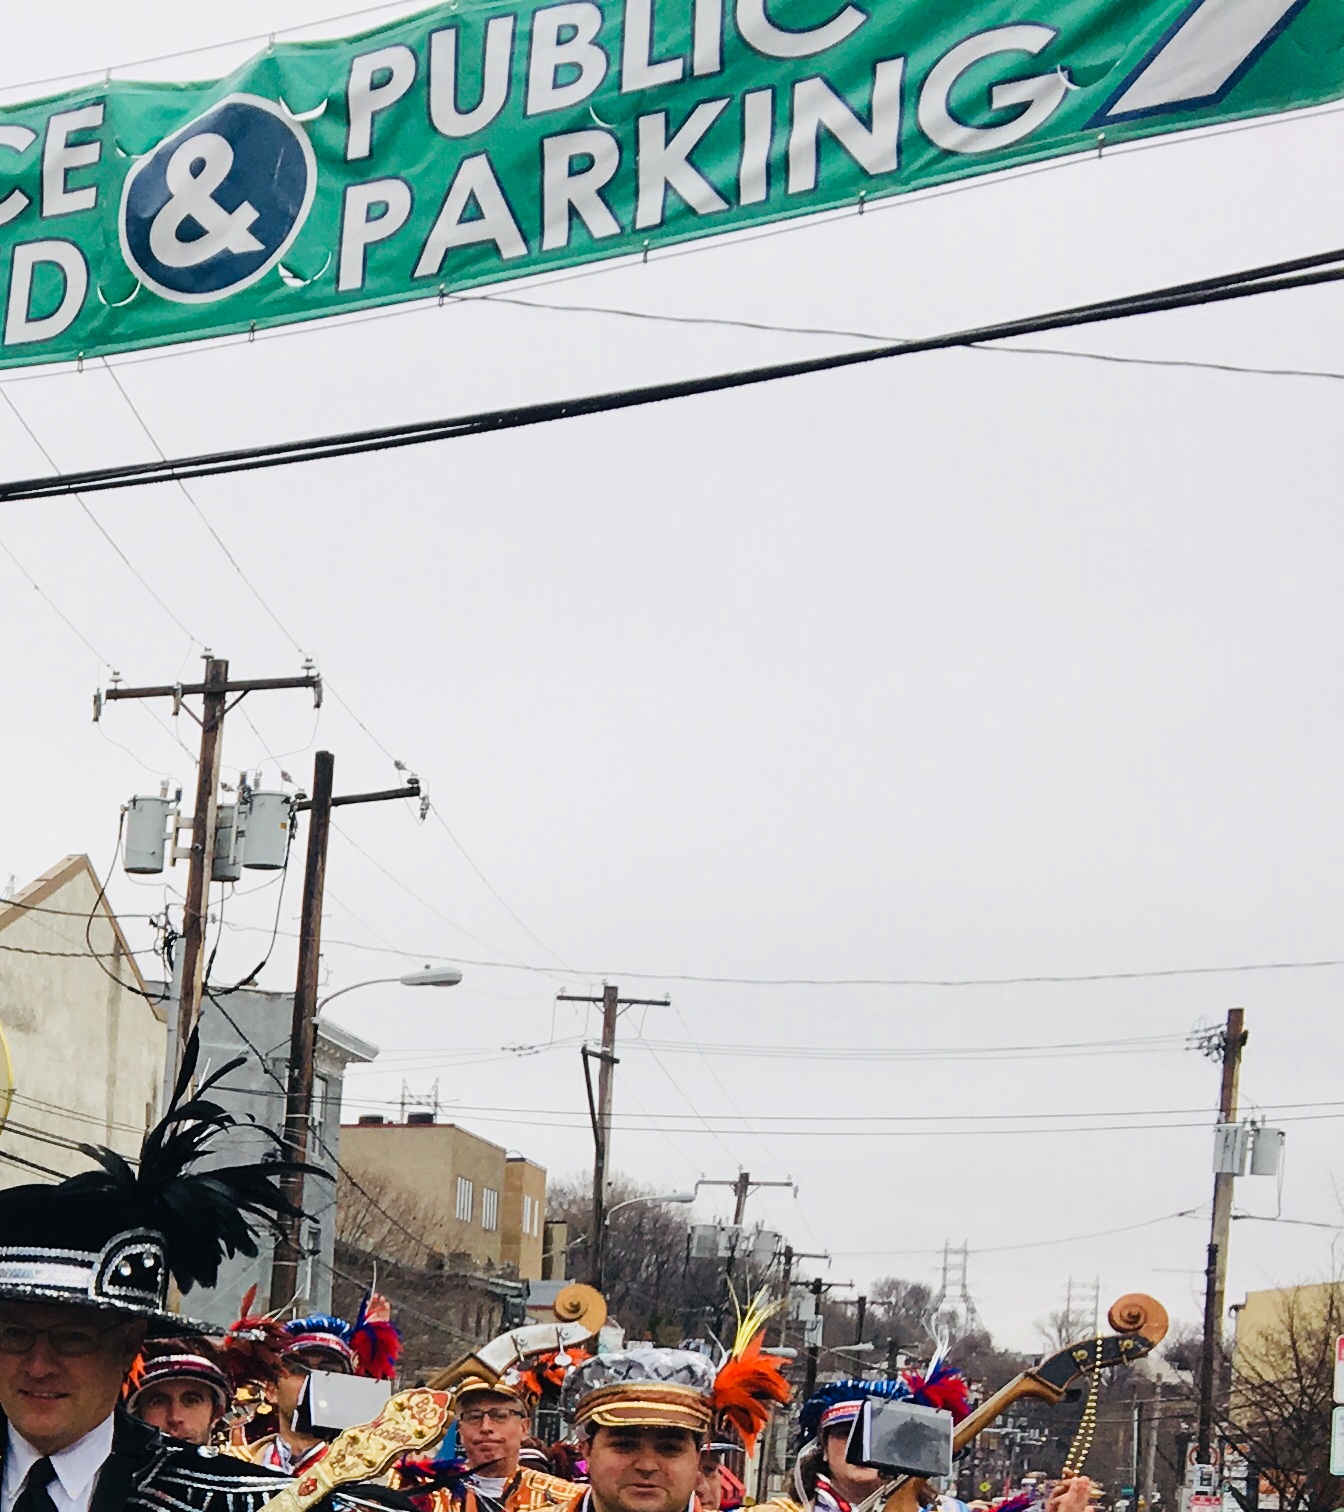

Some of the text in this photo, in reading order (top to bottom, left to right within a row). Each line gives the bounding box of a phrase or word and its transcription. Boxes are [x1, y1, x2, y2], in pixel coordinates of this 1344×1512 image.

[149, 132, 266, 268] &
[333, 24, 1068, 292] PARKING
[343, 0, 871, 161] PUBLIC
